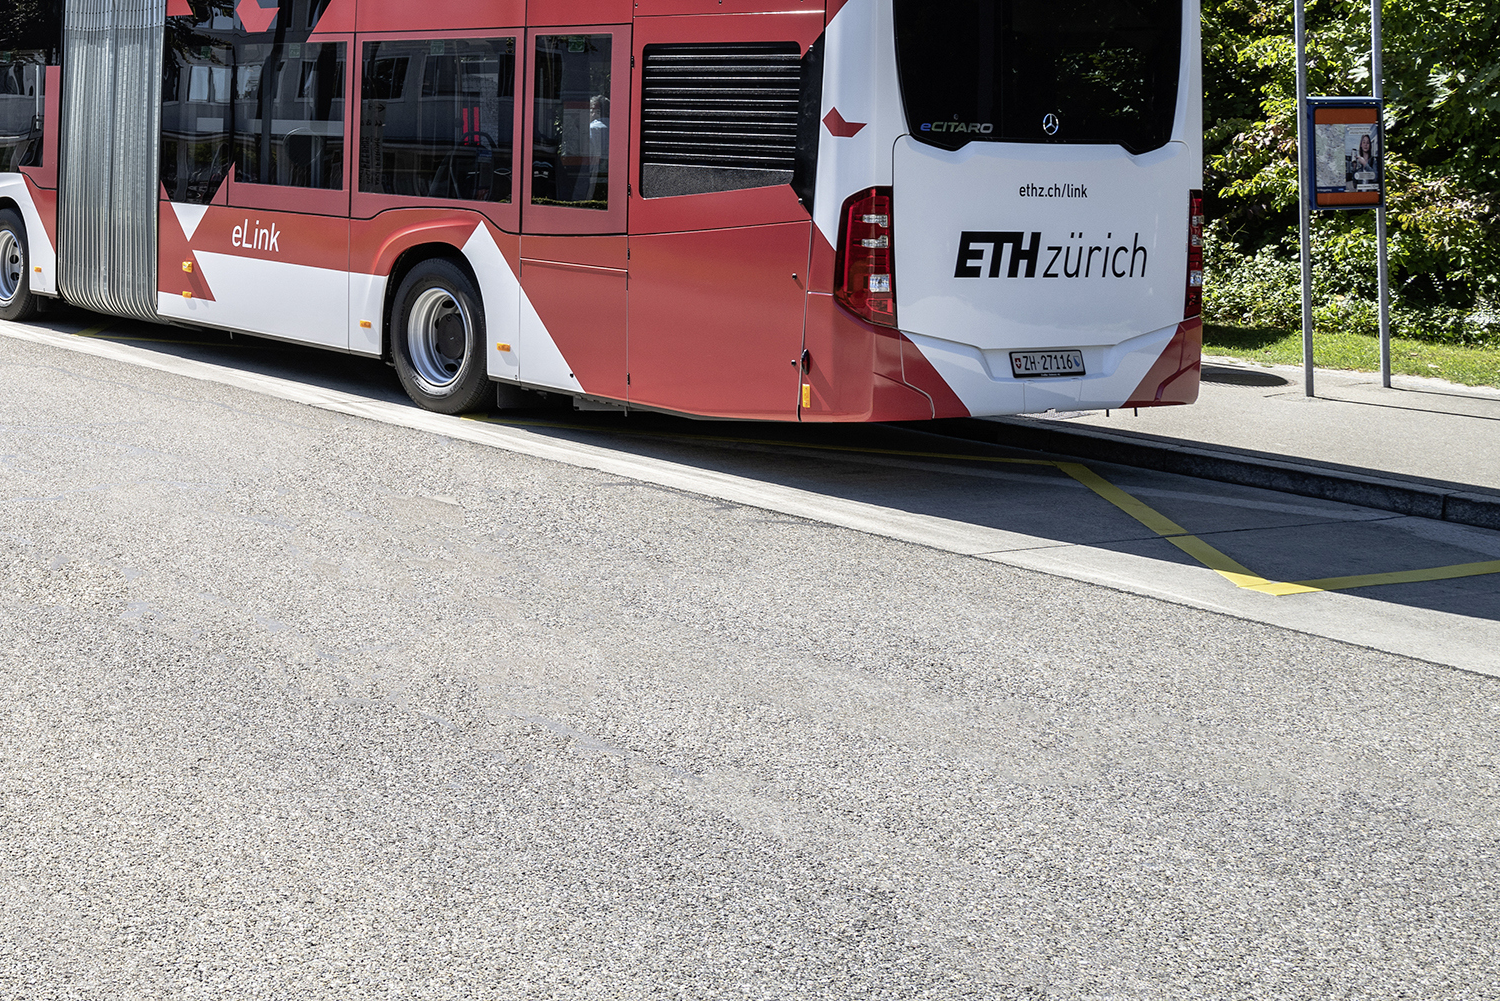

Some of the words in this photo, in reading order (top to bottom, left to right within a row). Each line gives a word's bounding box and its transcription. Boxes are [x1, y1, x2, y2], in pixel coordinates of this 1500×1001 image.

[920, 121, 993, 134] eCITARO
[1019, 183, 1088, 198] ethz.ch/link
[231, 218, 280, 252] eLink
